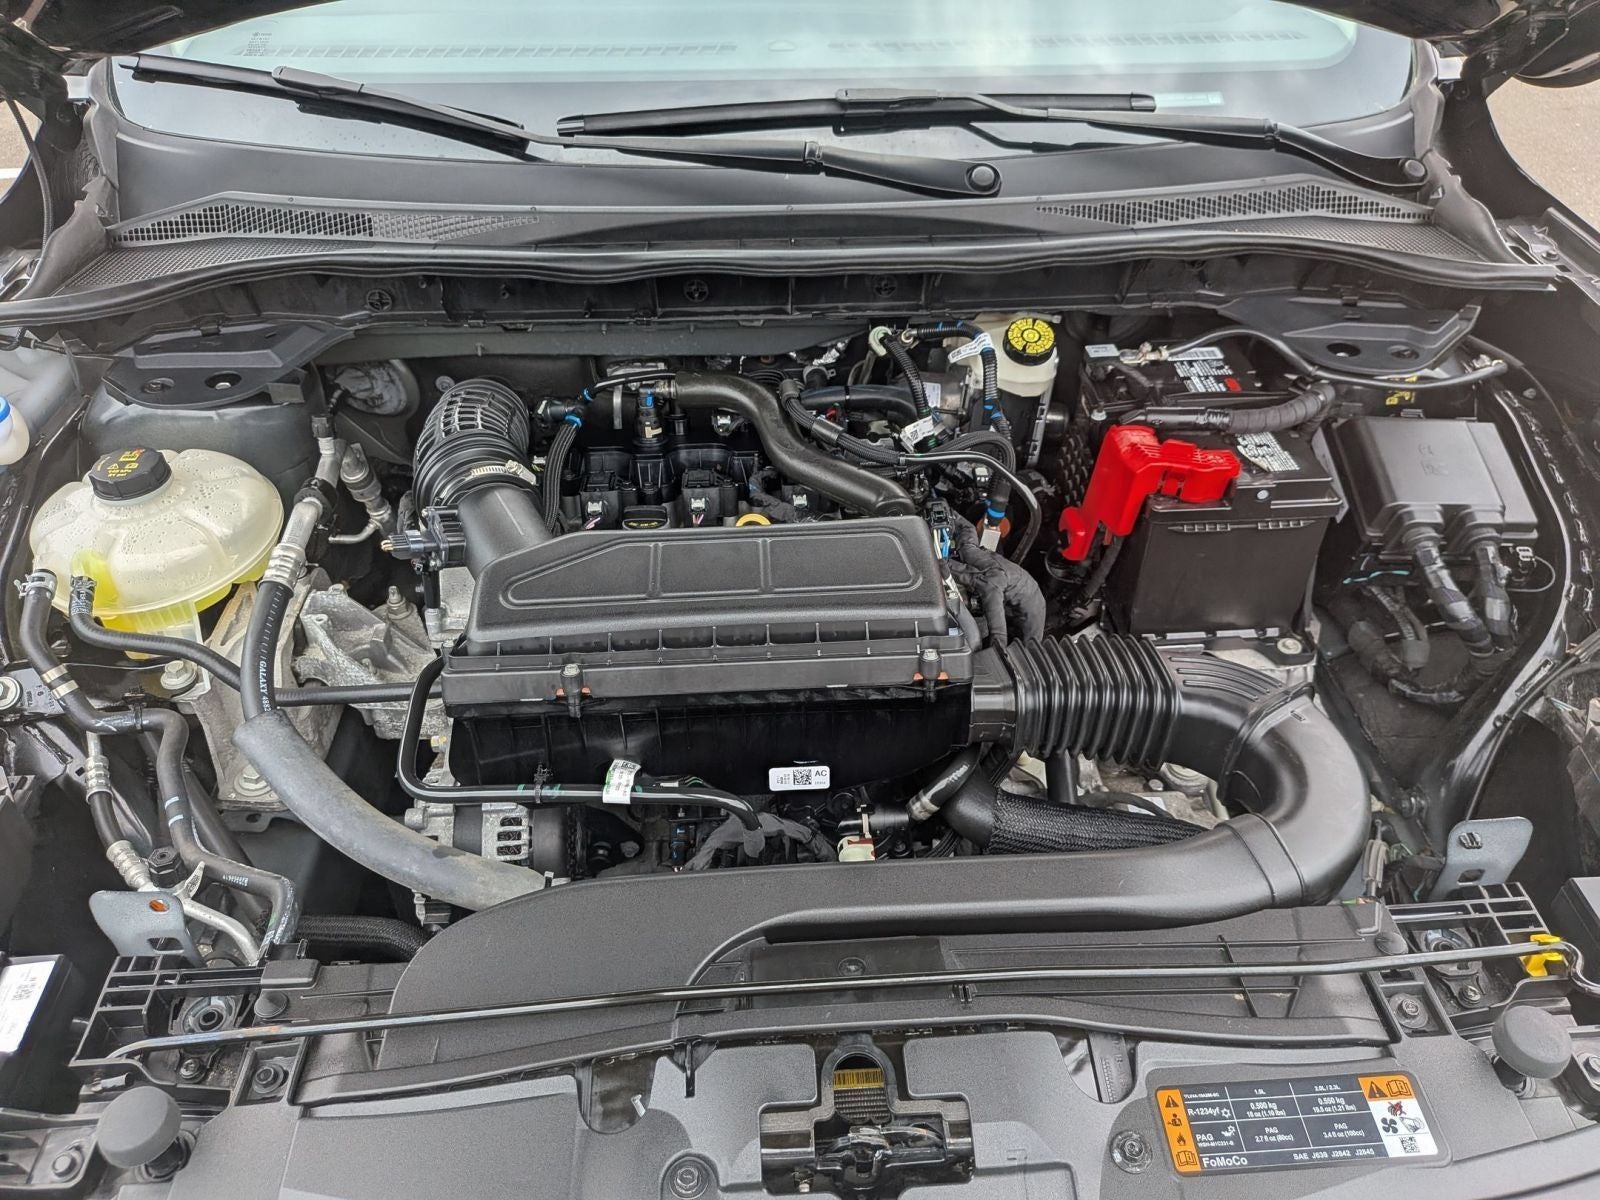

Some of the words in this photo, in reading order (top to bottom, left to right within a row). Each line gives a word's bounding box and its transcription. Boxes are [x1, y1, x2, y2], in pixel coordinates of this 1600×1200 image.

[259, 661, 268, 695] GALAXY
[1268, 1102, 1277, 1110] kg
[1336, 1097, 1345, 1105] kg
[1188, 1106, 1220, 1117] R-1234yf
[1202, 1156, 1248, 1168] FoMoCo
